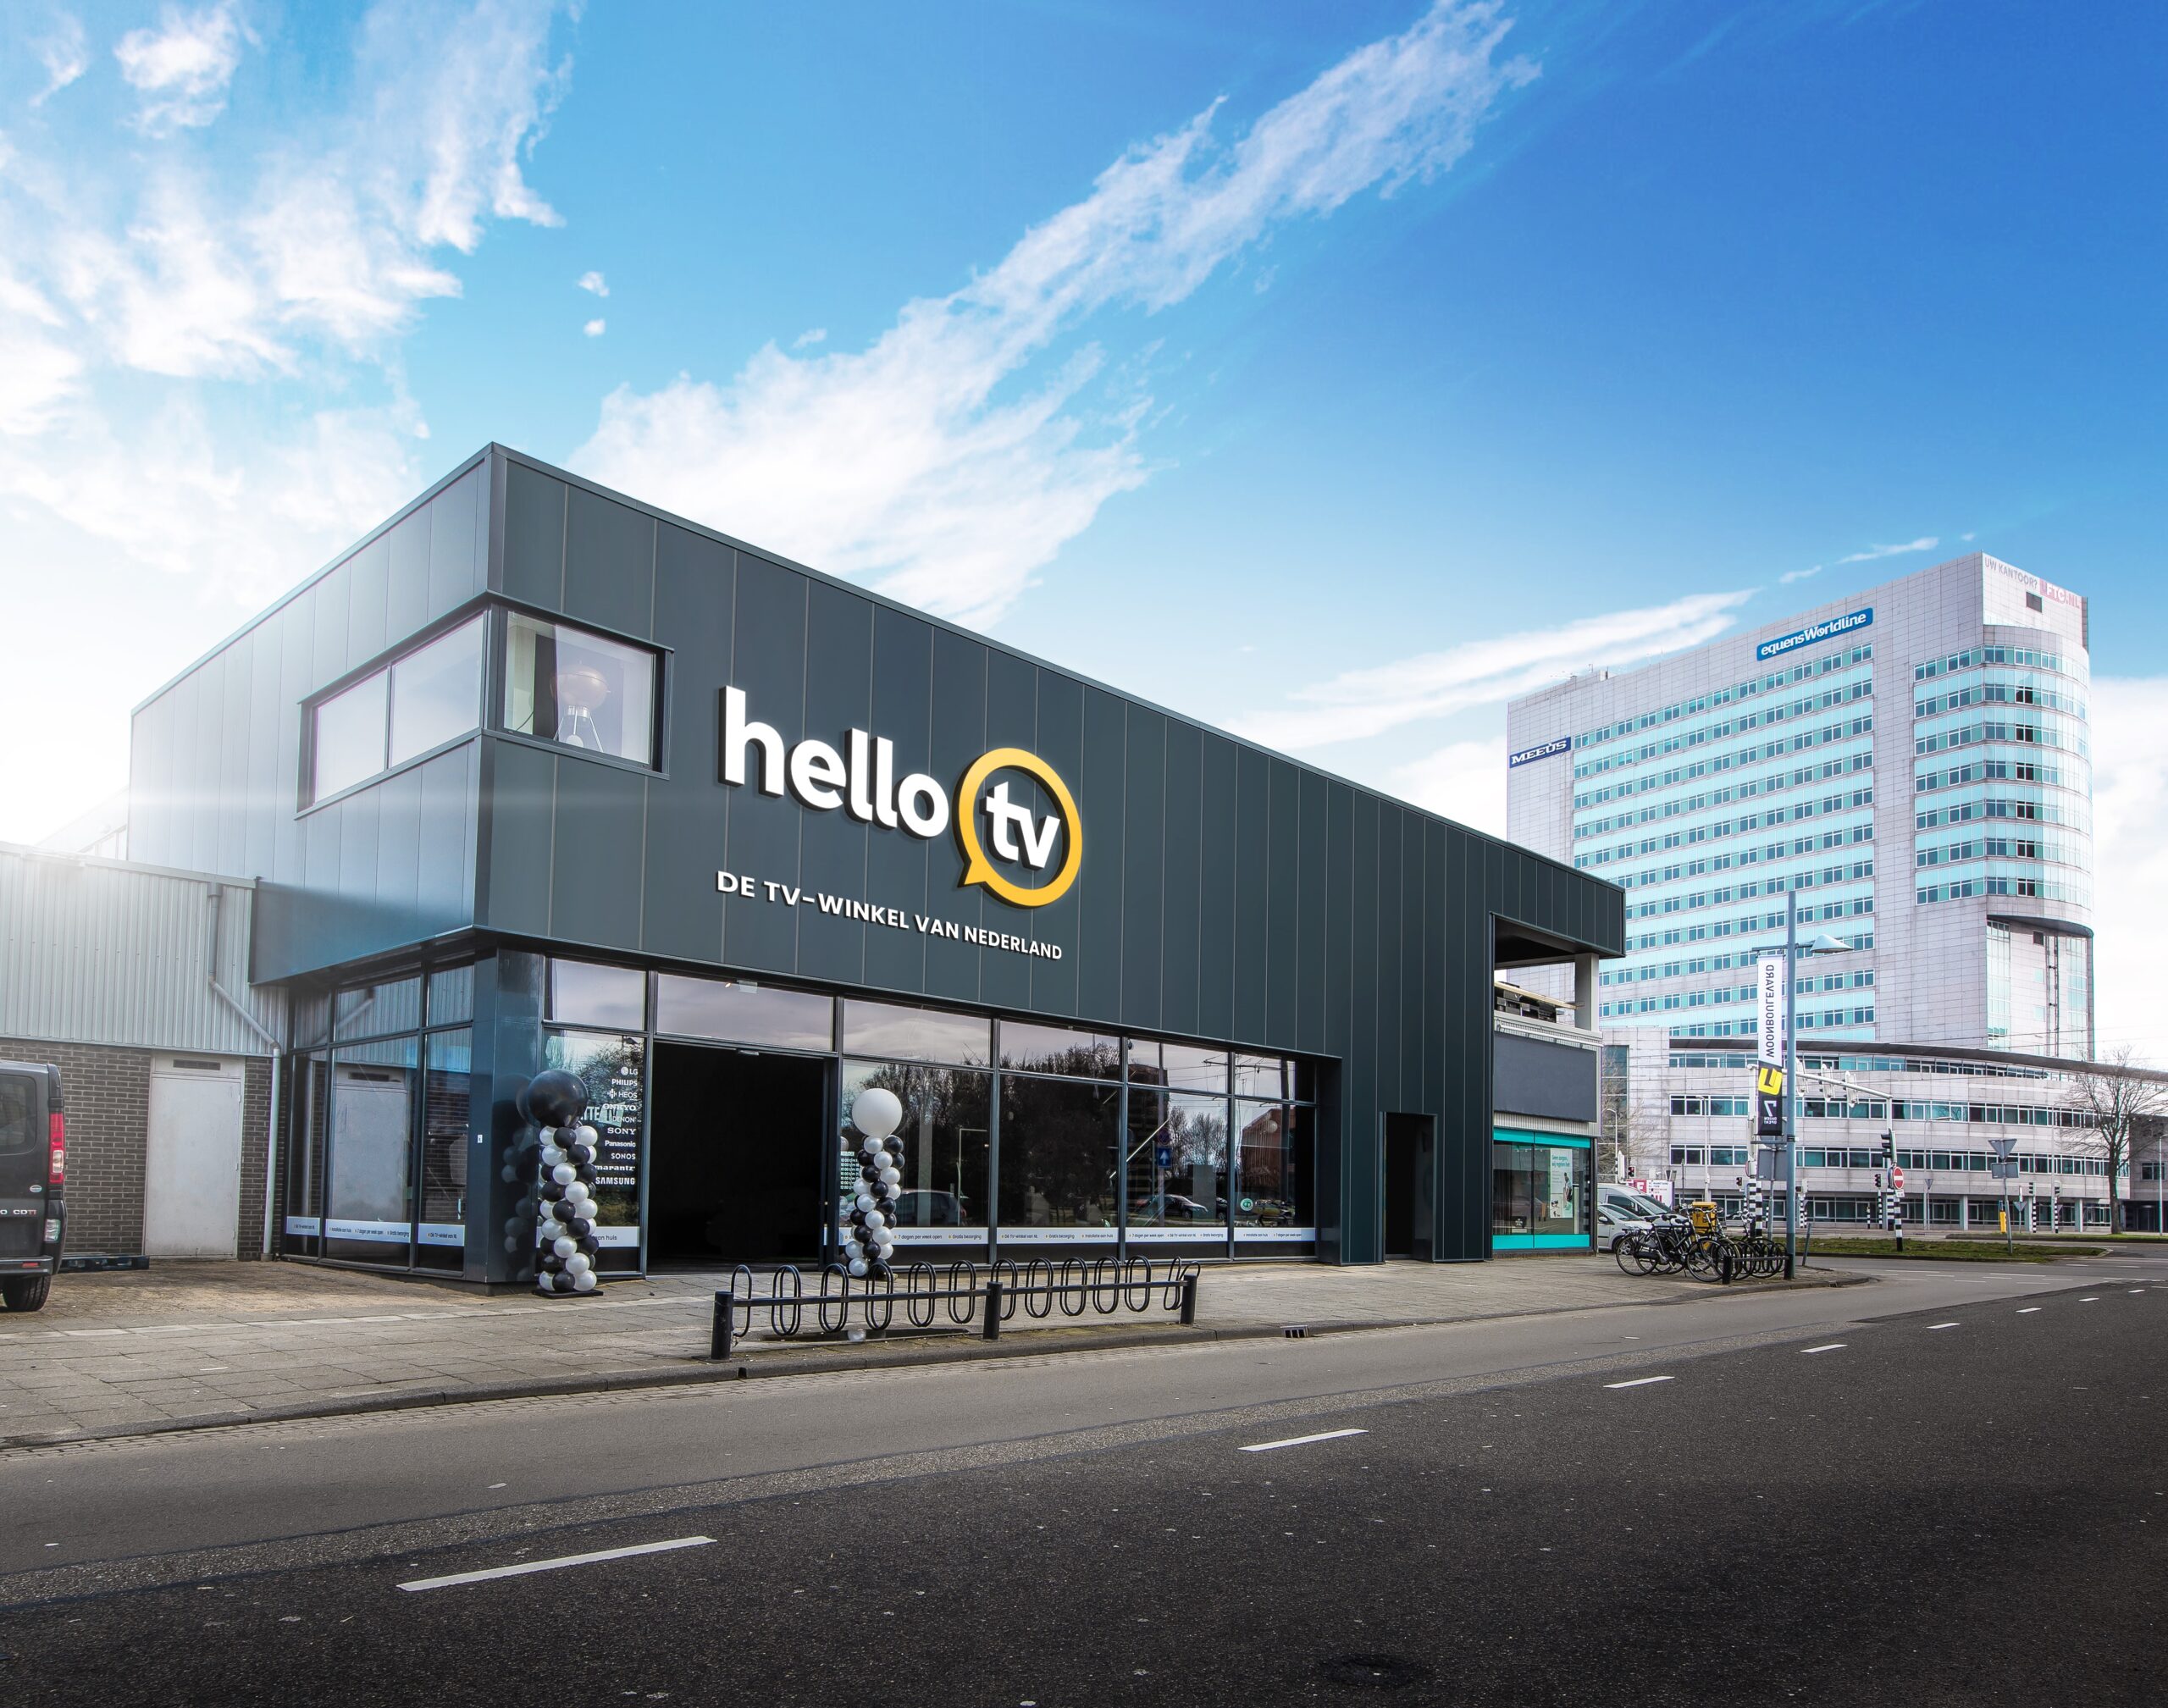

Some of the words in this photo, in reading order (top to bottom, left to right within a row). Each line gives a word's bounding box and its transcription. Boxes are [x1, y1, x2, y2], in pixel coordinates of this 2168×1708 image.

[1761, 613, 1867, 655] equensWorldline
[720, 684, 949, 839] hello
[982, 781, 1061, 871] tv
[717, 870, 755, 898] DE
[763, 880, 910, 930] TV-WINKEL
[915, 914, 959, 940] VAN
[964, 927, 1062, 960] NEDERLAND
[611, 1078, 638, 1086] PHILIPS
